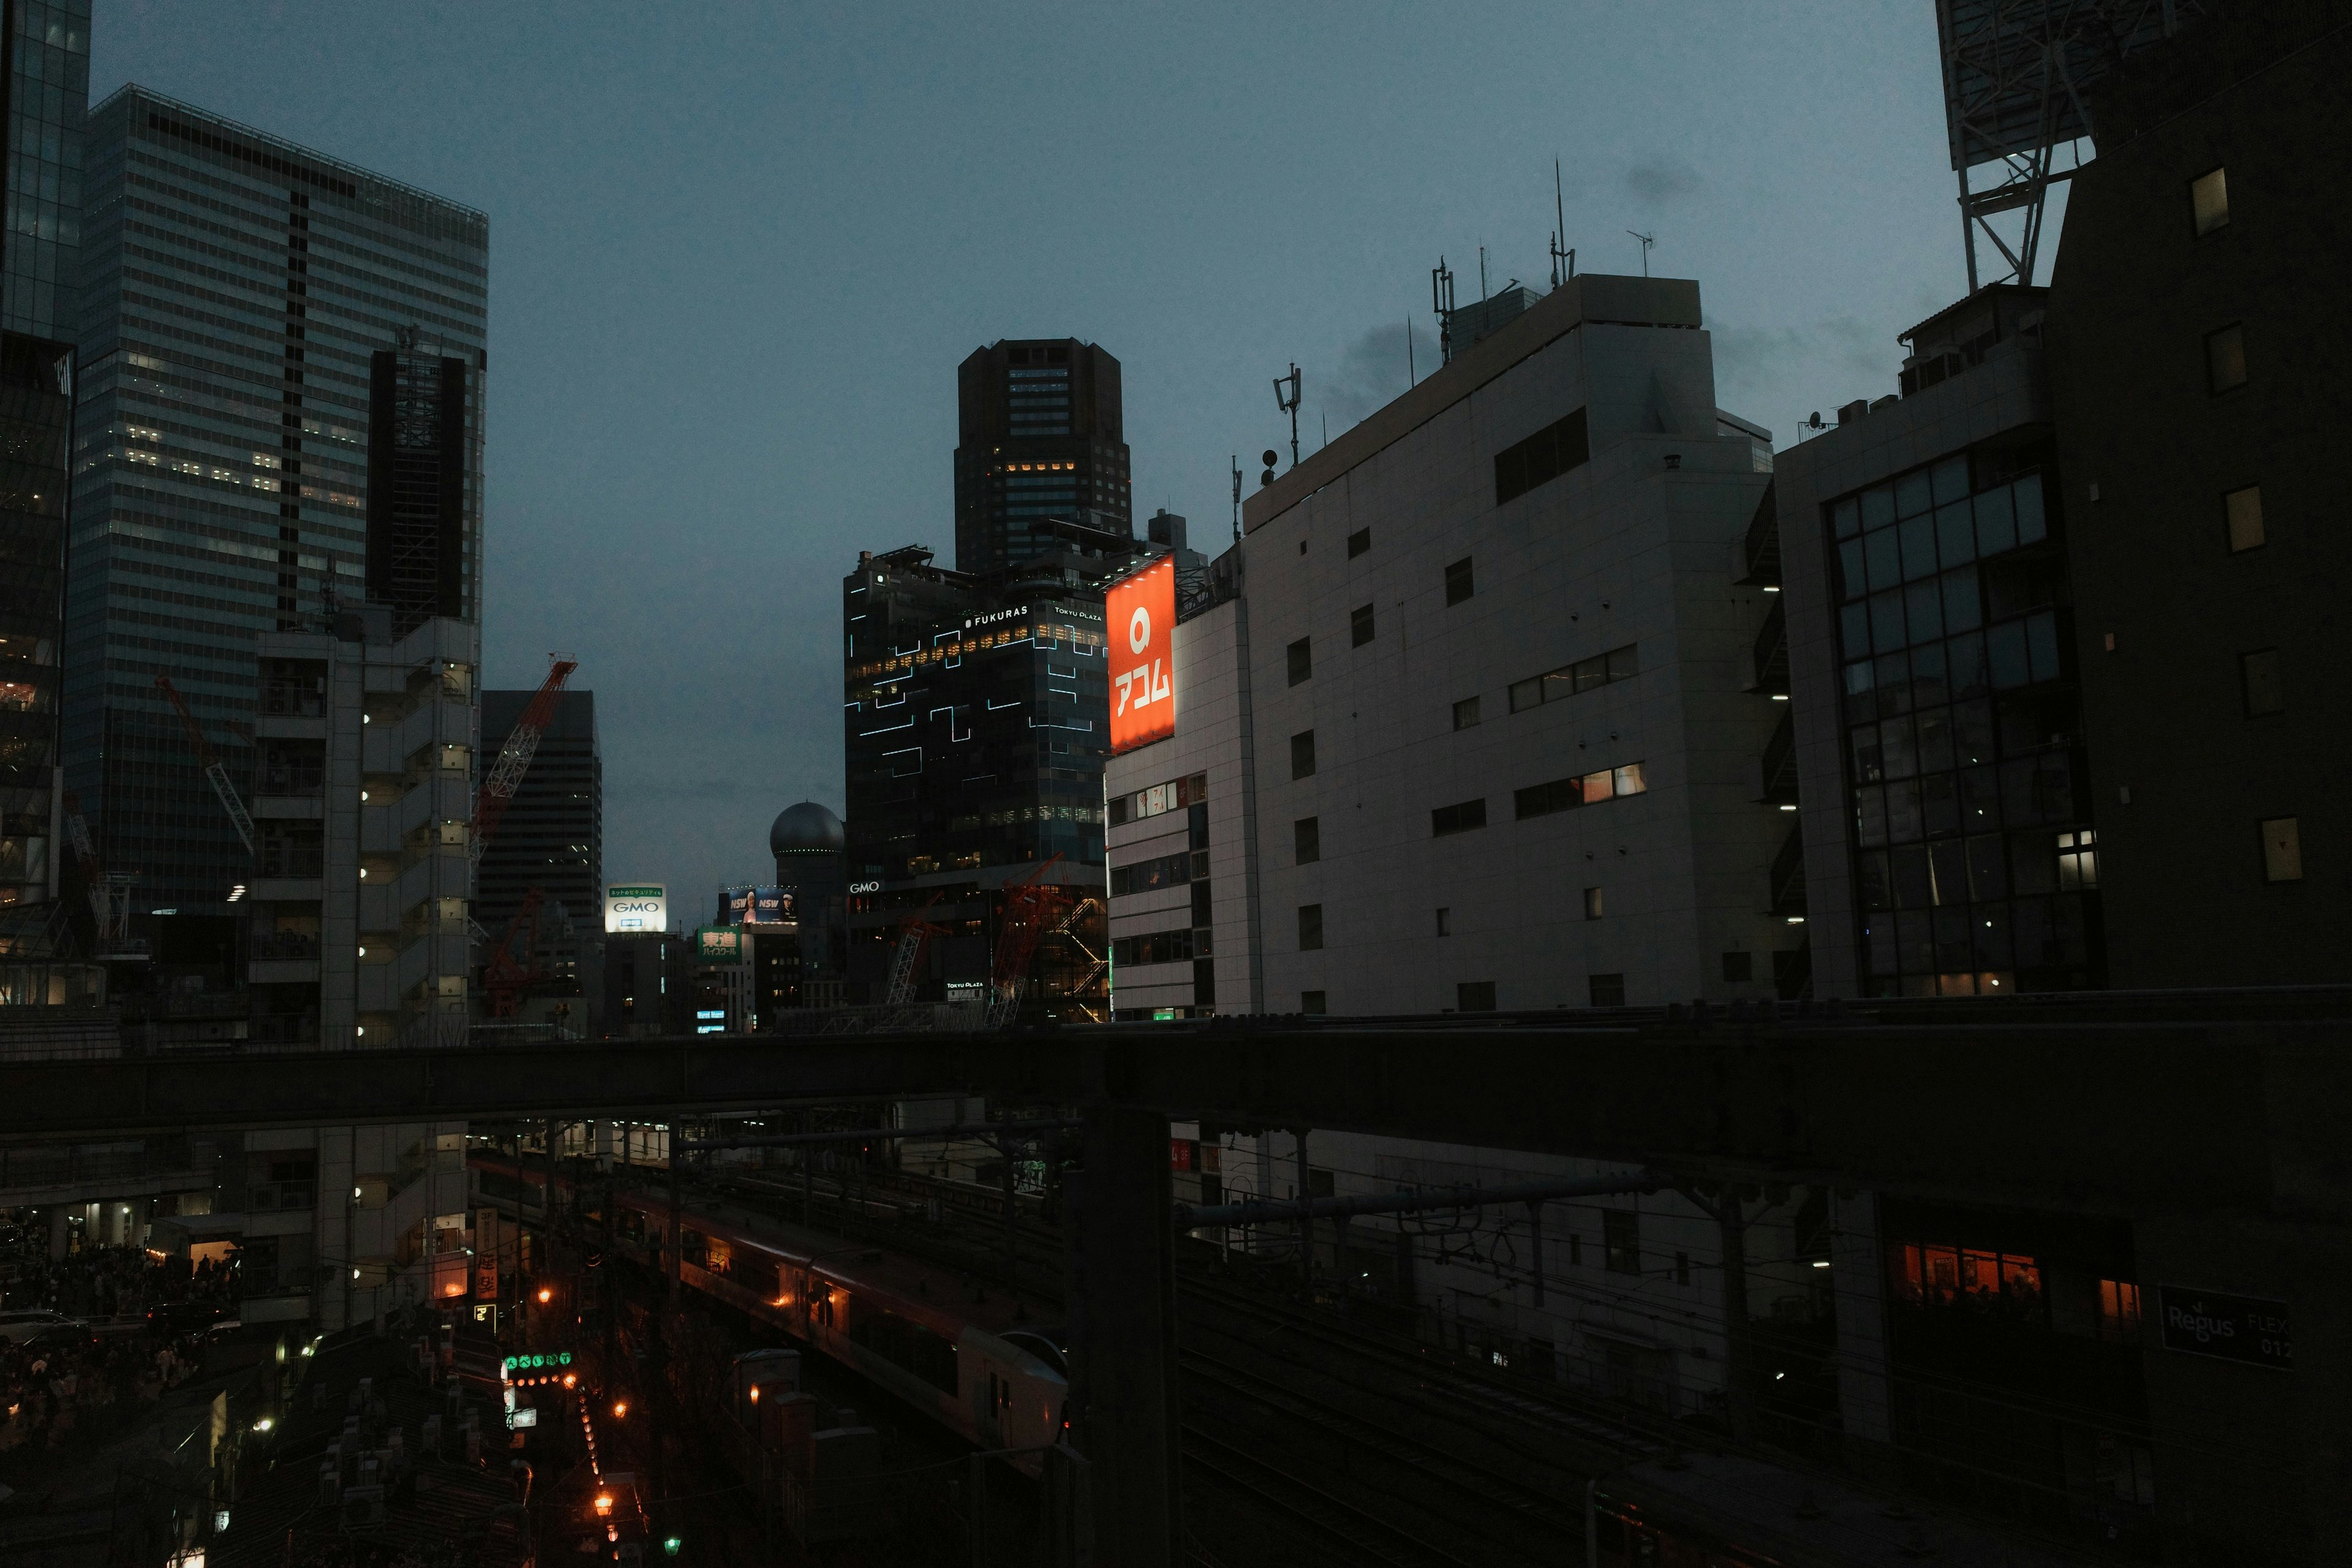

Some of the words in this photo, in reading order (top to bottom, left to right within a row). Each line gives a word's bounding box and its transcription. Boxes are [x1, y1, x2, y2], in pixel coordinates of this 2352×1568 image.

[975, 605, 1028, 626] FUKURAS
[1115, 658, 1170, 717] アコム
[850, 881, 880, 894] GMO
[613, 902, 658, 913] GMO
[731, 898, 747, 909] NSW
[759, 899, 778, 908] NSW
[703, 932, 736, 947] 東進
[2168, 1305, 2234, 1342] Regus
